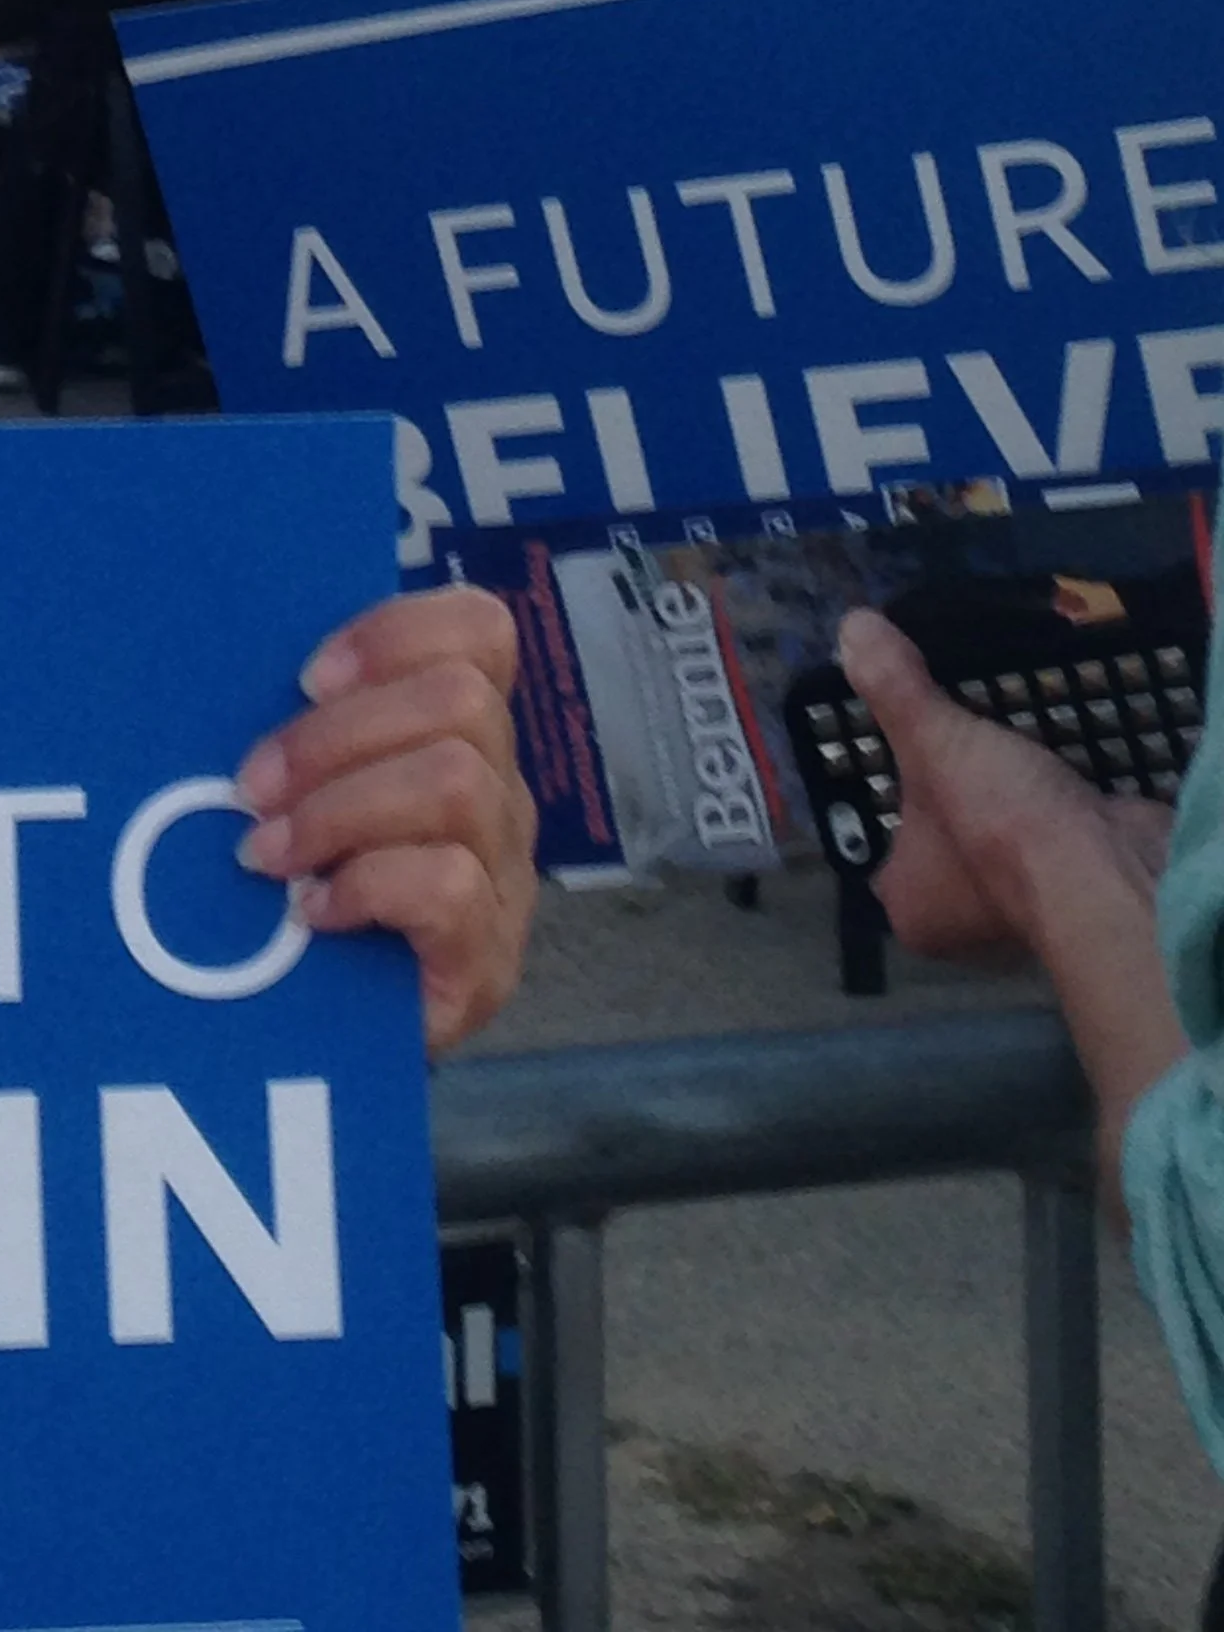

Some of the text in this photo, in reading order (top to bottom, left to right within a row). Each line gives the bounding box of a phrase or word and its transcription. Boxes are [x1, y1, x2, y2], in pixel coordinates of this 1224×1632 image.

[283, 116, 1224, 366] A FUTURE
[655, 579, 766, 849] Bernie
